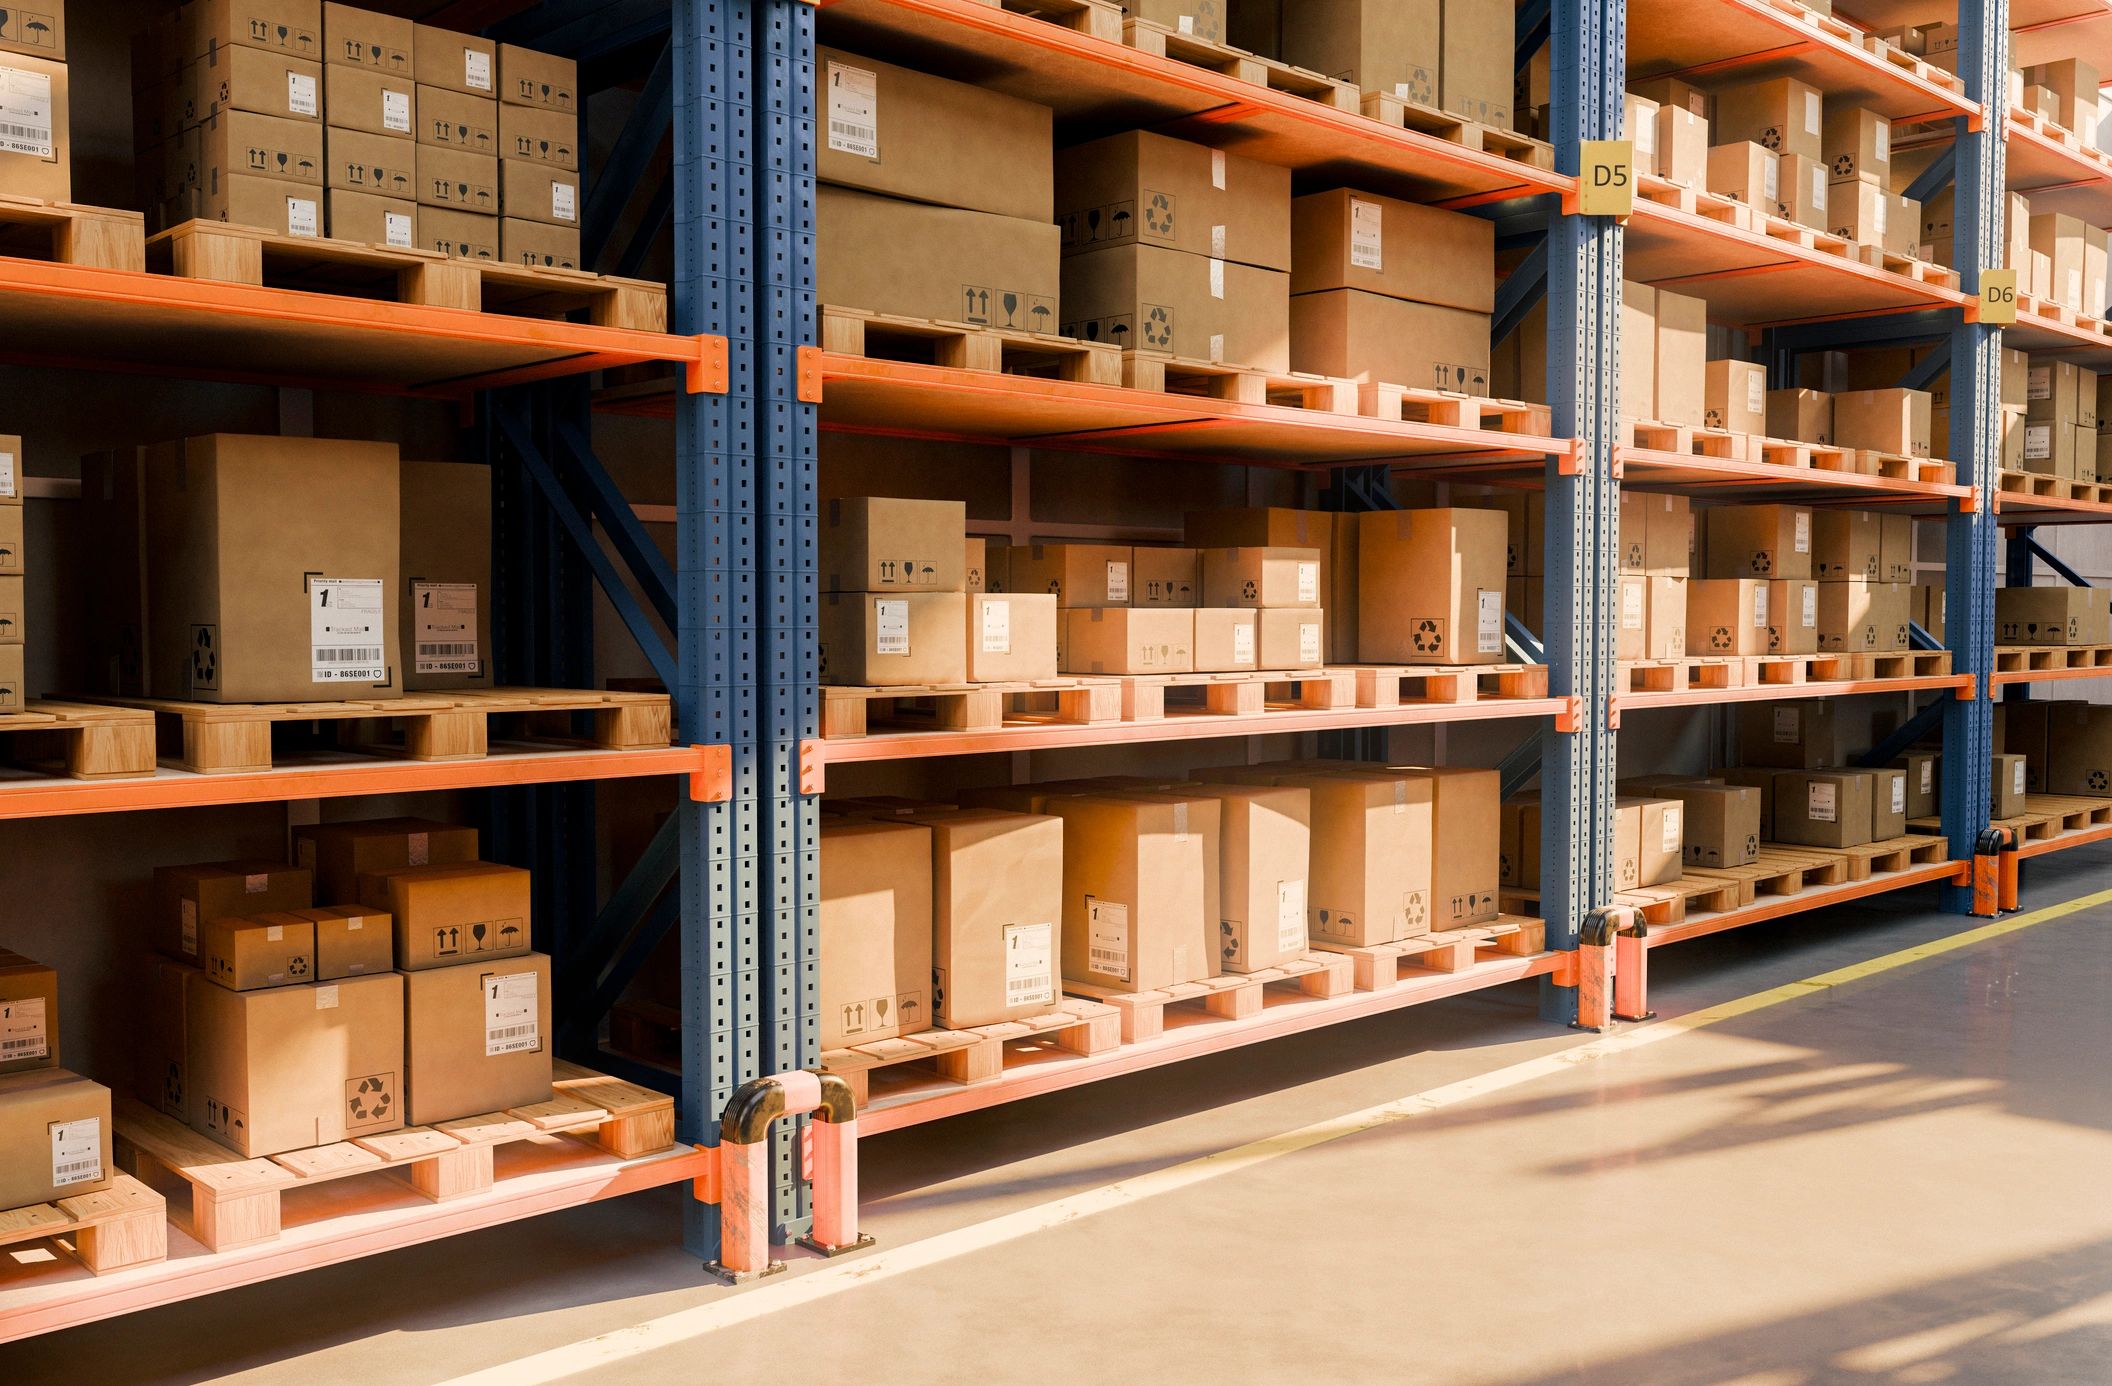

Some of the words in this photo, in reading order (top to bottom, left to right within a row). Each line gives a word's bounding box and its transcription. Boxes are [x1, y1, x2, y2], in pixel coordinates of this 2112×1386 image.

[834, 71, 840, 87] 1
[11, 142, 39, 153] 86SE001
[1594, 164, 1627, 187] D5
[1355, 207, 1359, 218] 1
[1988, 286, 2013, 303] D6
[320, 588, 329, 607] 1
[422, 591, 430, 608] 1
[881, 606, 885, 616] 1
[440, 662, 466, 670] 86SE001
[340, 670, 370, 678] 86SE001
[1093, 907, 1098, 920] 1
[1012, 935, 1018, 949] 1
[492, 984, 498, 999] 1
[4, 1007, 10, 1019] 1
[57, 1130, 64, 1141] 1
